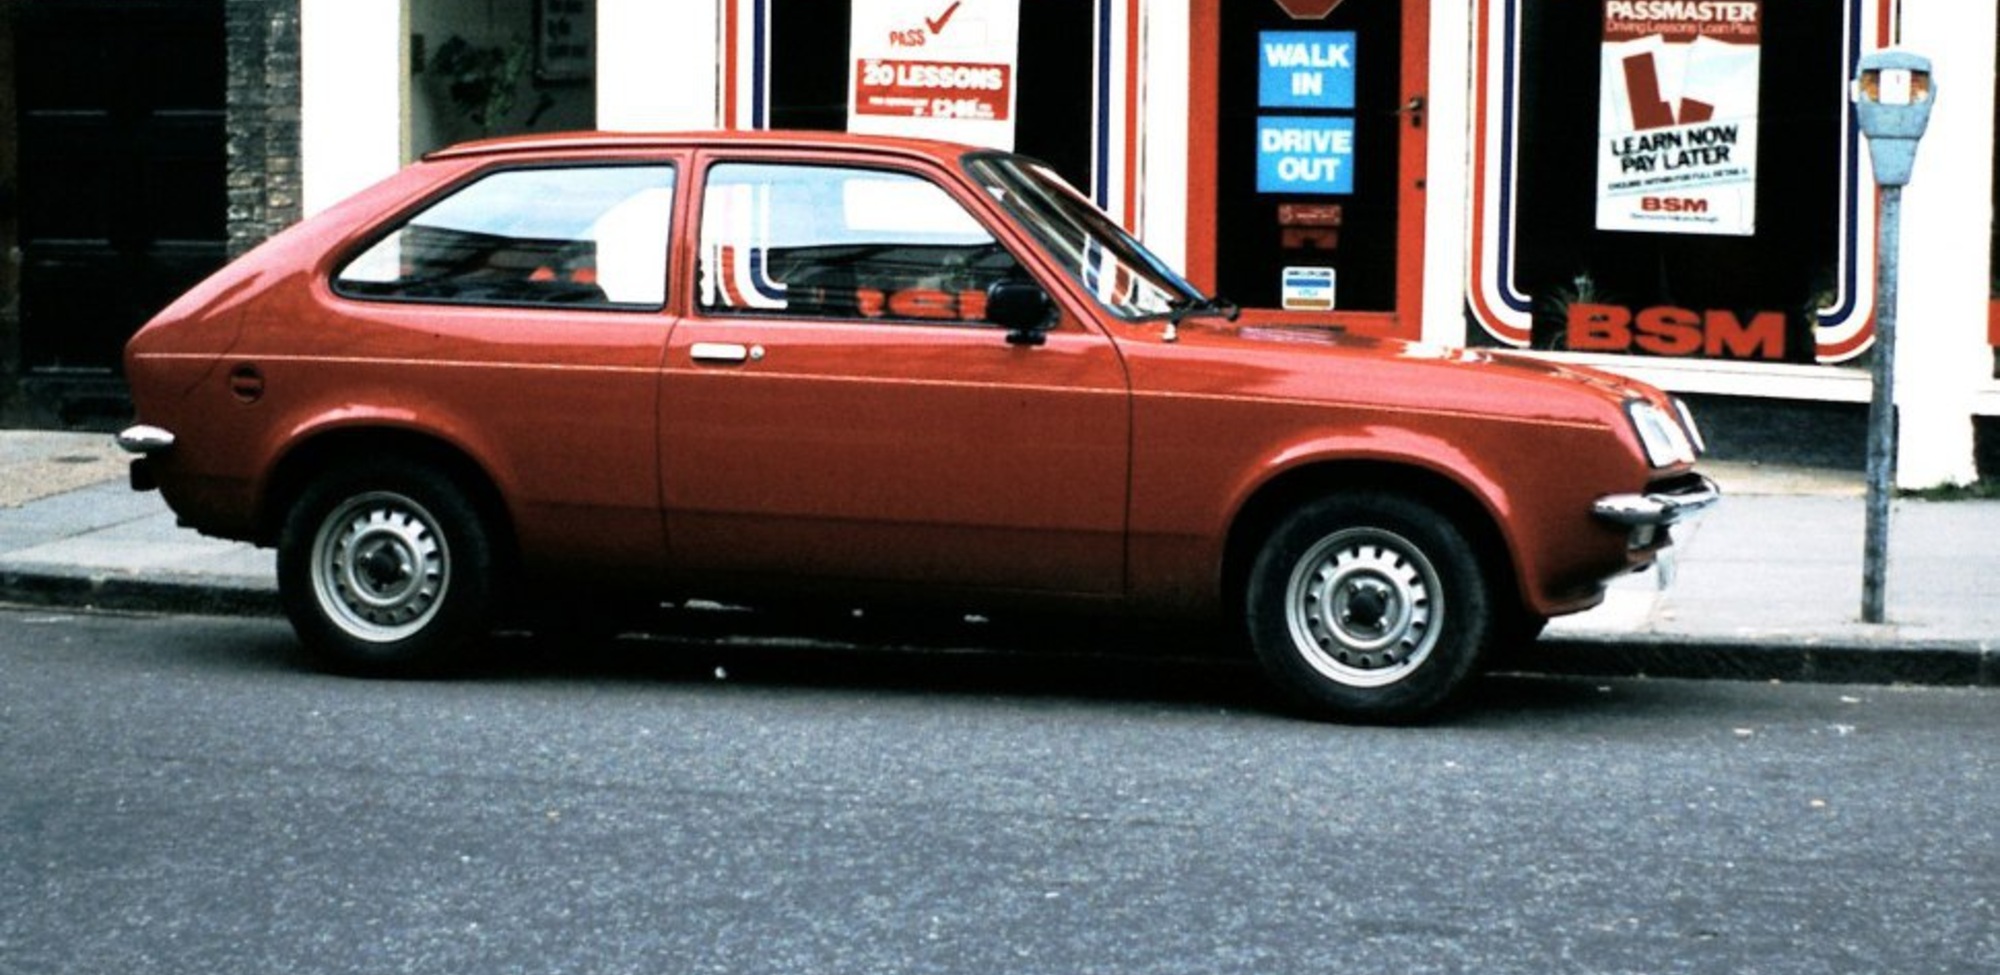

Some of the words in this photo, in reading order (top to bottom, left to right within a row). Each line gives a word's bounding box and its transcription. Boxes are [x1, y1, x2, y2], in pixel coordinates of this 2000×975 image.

[1606, 1, 1757, 21] PASSMASTER
[890, 29, 926, 47] PASS
[1606, 21, 1645, 34] Driving
[1648, 21, 1696, 33] Lessons
[1699, 22, 1729, 33] Loan
[1731, 22, 1757, 33] Plan
[1264, 43, 1350, 68] WALK
[863, 64, 894, 86] 20
[897, 65, 1003, 91] LESSONS
[1291, 72, 1323, 96] IN
[1261, 128, 1353, 154] DRIVE
[1611, 131, 1682, 156] LEARN
[1687, 124, 1738, 145] NOW
[1277, 156, 1341, 182] OUT
[1621, 154, 1657, 174] PAY
[1663, 145, 1730, 171] LATER
[1641, 195, 1709, 213] BSM
[1566, 303, 1786, 358] BSM
